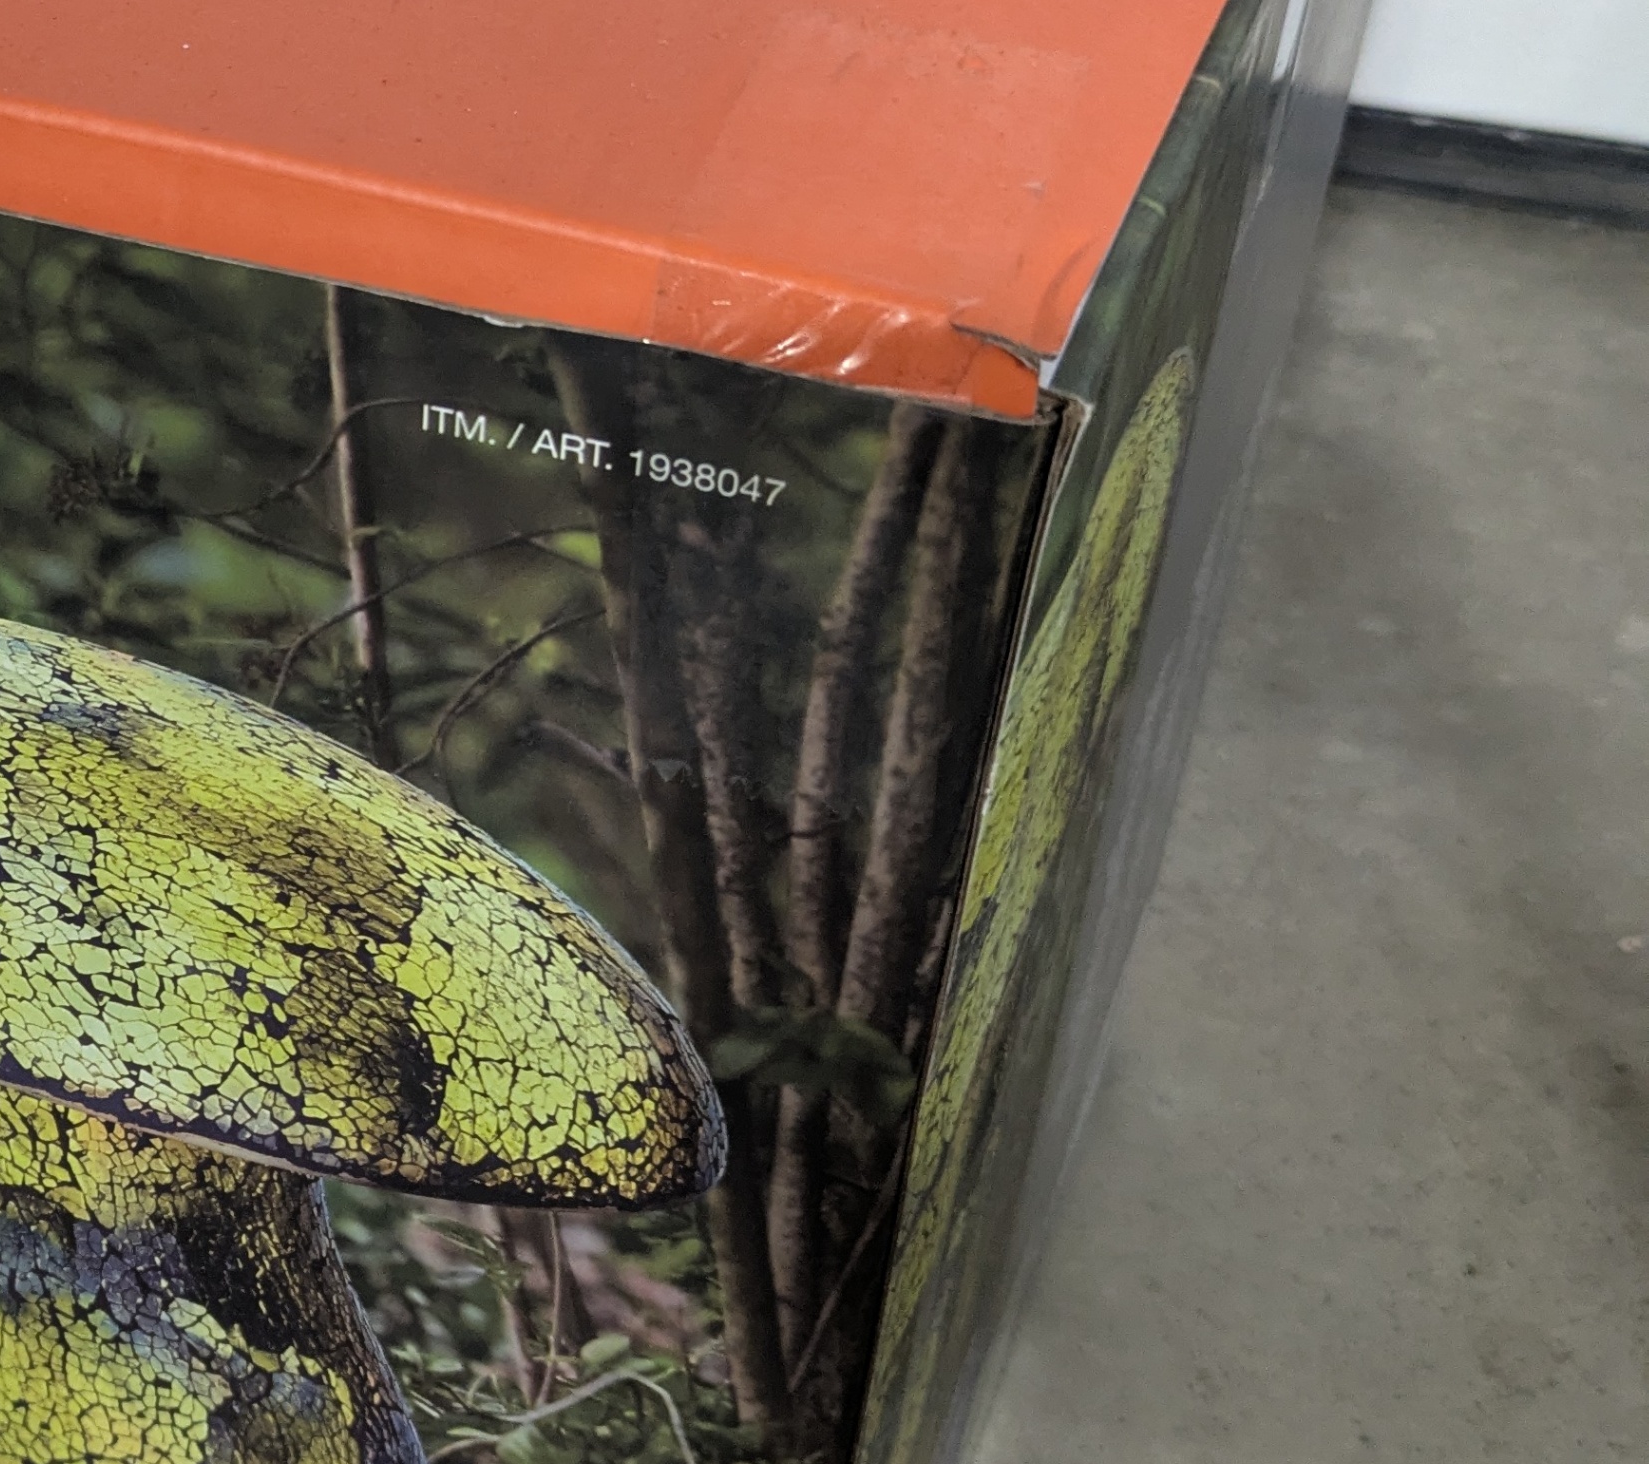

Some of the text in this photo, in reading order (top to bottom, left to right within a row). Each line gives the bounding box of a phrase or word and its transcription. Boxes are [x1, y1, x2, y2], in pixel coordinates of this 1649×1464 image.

[421, 403, 787, 507] ITM. / ART. 1938047
